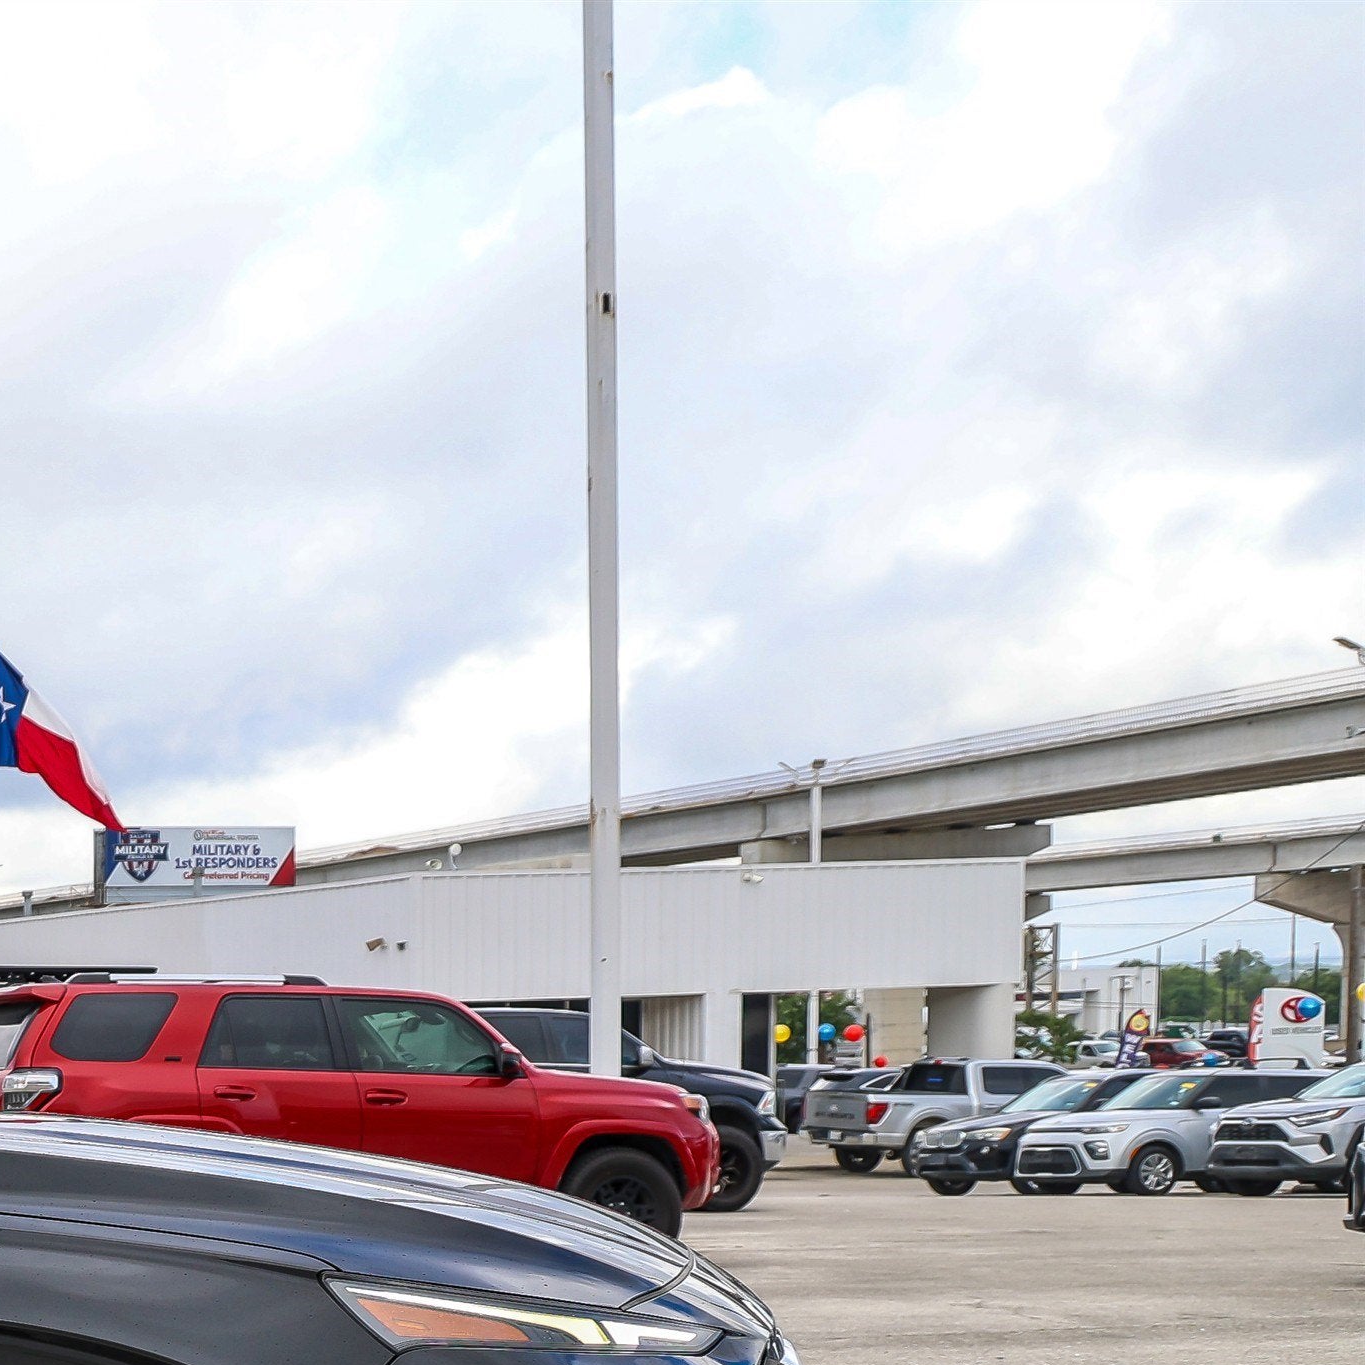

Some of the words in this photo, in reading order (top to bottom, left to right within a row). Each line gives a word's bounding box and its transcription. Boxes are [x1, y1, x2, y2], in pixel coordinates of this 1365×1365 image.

[115, 845, 166, 855] MILITARY
[192, 844, 249, 856] MILITARY
[253, 844, 261, 856] &
[175, 857, 193, 869] 1st
[195, 857, 278, 869] RESPONDERS
[202, 871, 239, 880] referred
